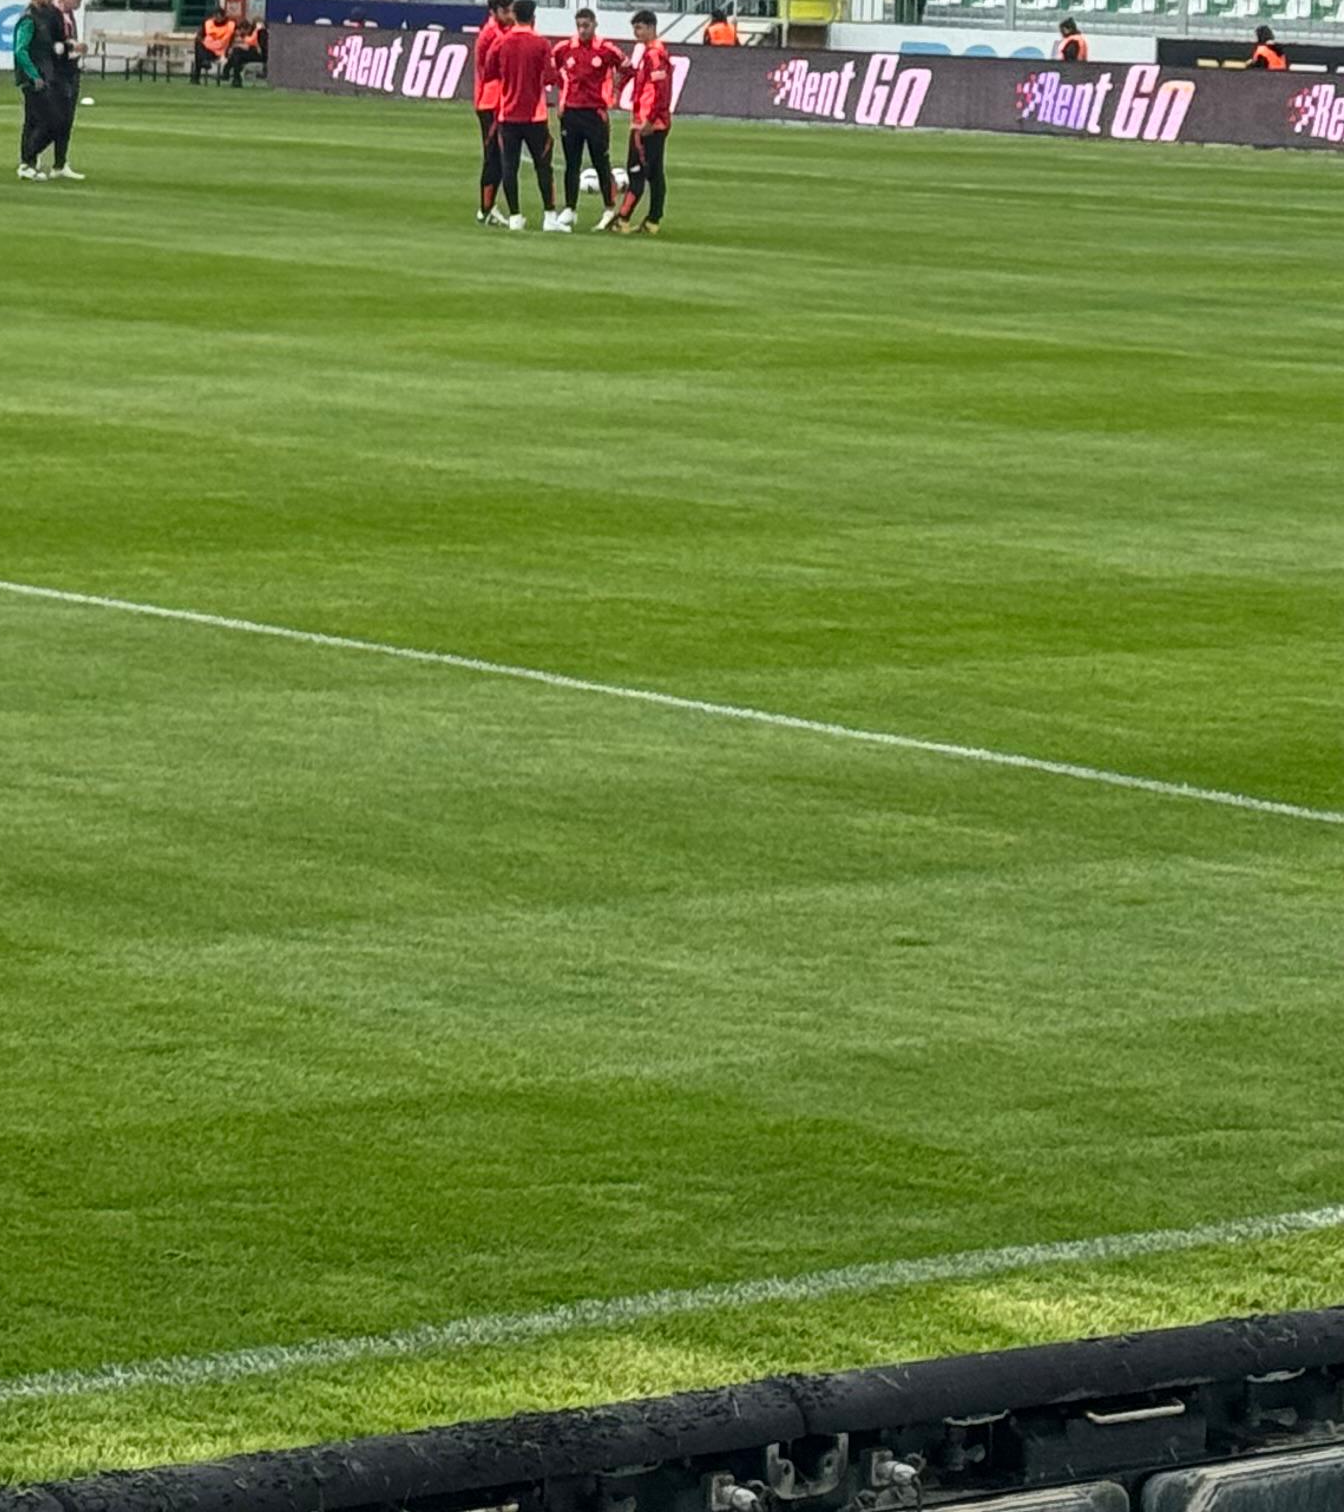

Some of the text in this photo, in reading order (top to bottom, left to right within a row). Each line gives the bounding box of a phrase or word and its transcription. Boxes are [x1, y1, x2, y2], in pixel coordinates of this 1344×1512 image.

[344, 35, 403, 92] Rent
[787, 59, 856, 120] Rent
[1038, 71, 1113, 134] Rent
